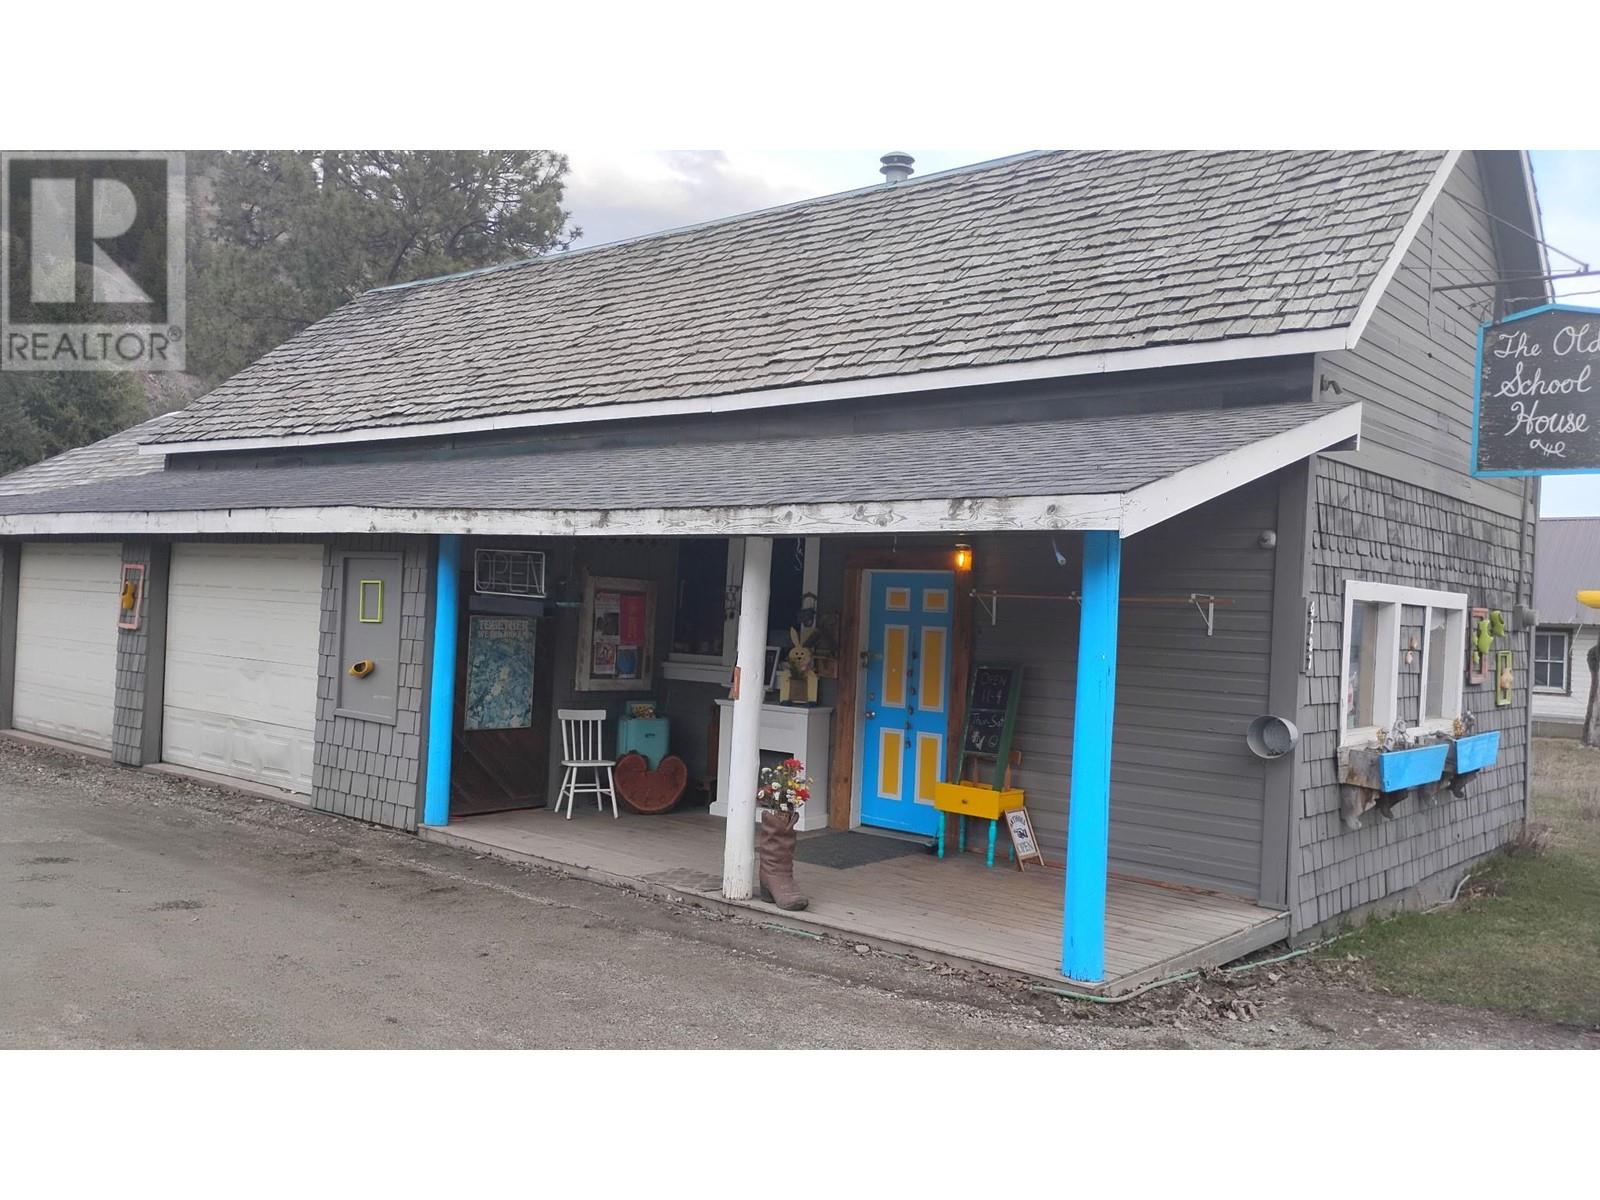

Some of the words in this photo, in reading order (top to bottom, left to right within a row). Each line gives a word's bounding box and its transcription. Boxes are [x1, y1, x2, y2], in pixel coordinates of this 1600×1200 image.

[1494, 330, 1542, 358] The
[1553, 323, 1600, 356] Old
[1494, 361, 1592, 397] School
[1504, 400, 1589, 436] House
[477, 552, 542, 593] OPEN
